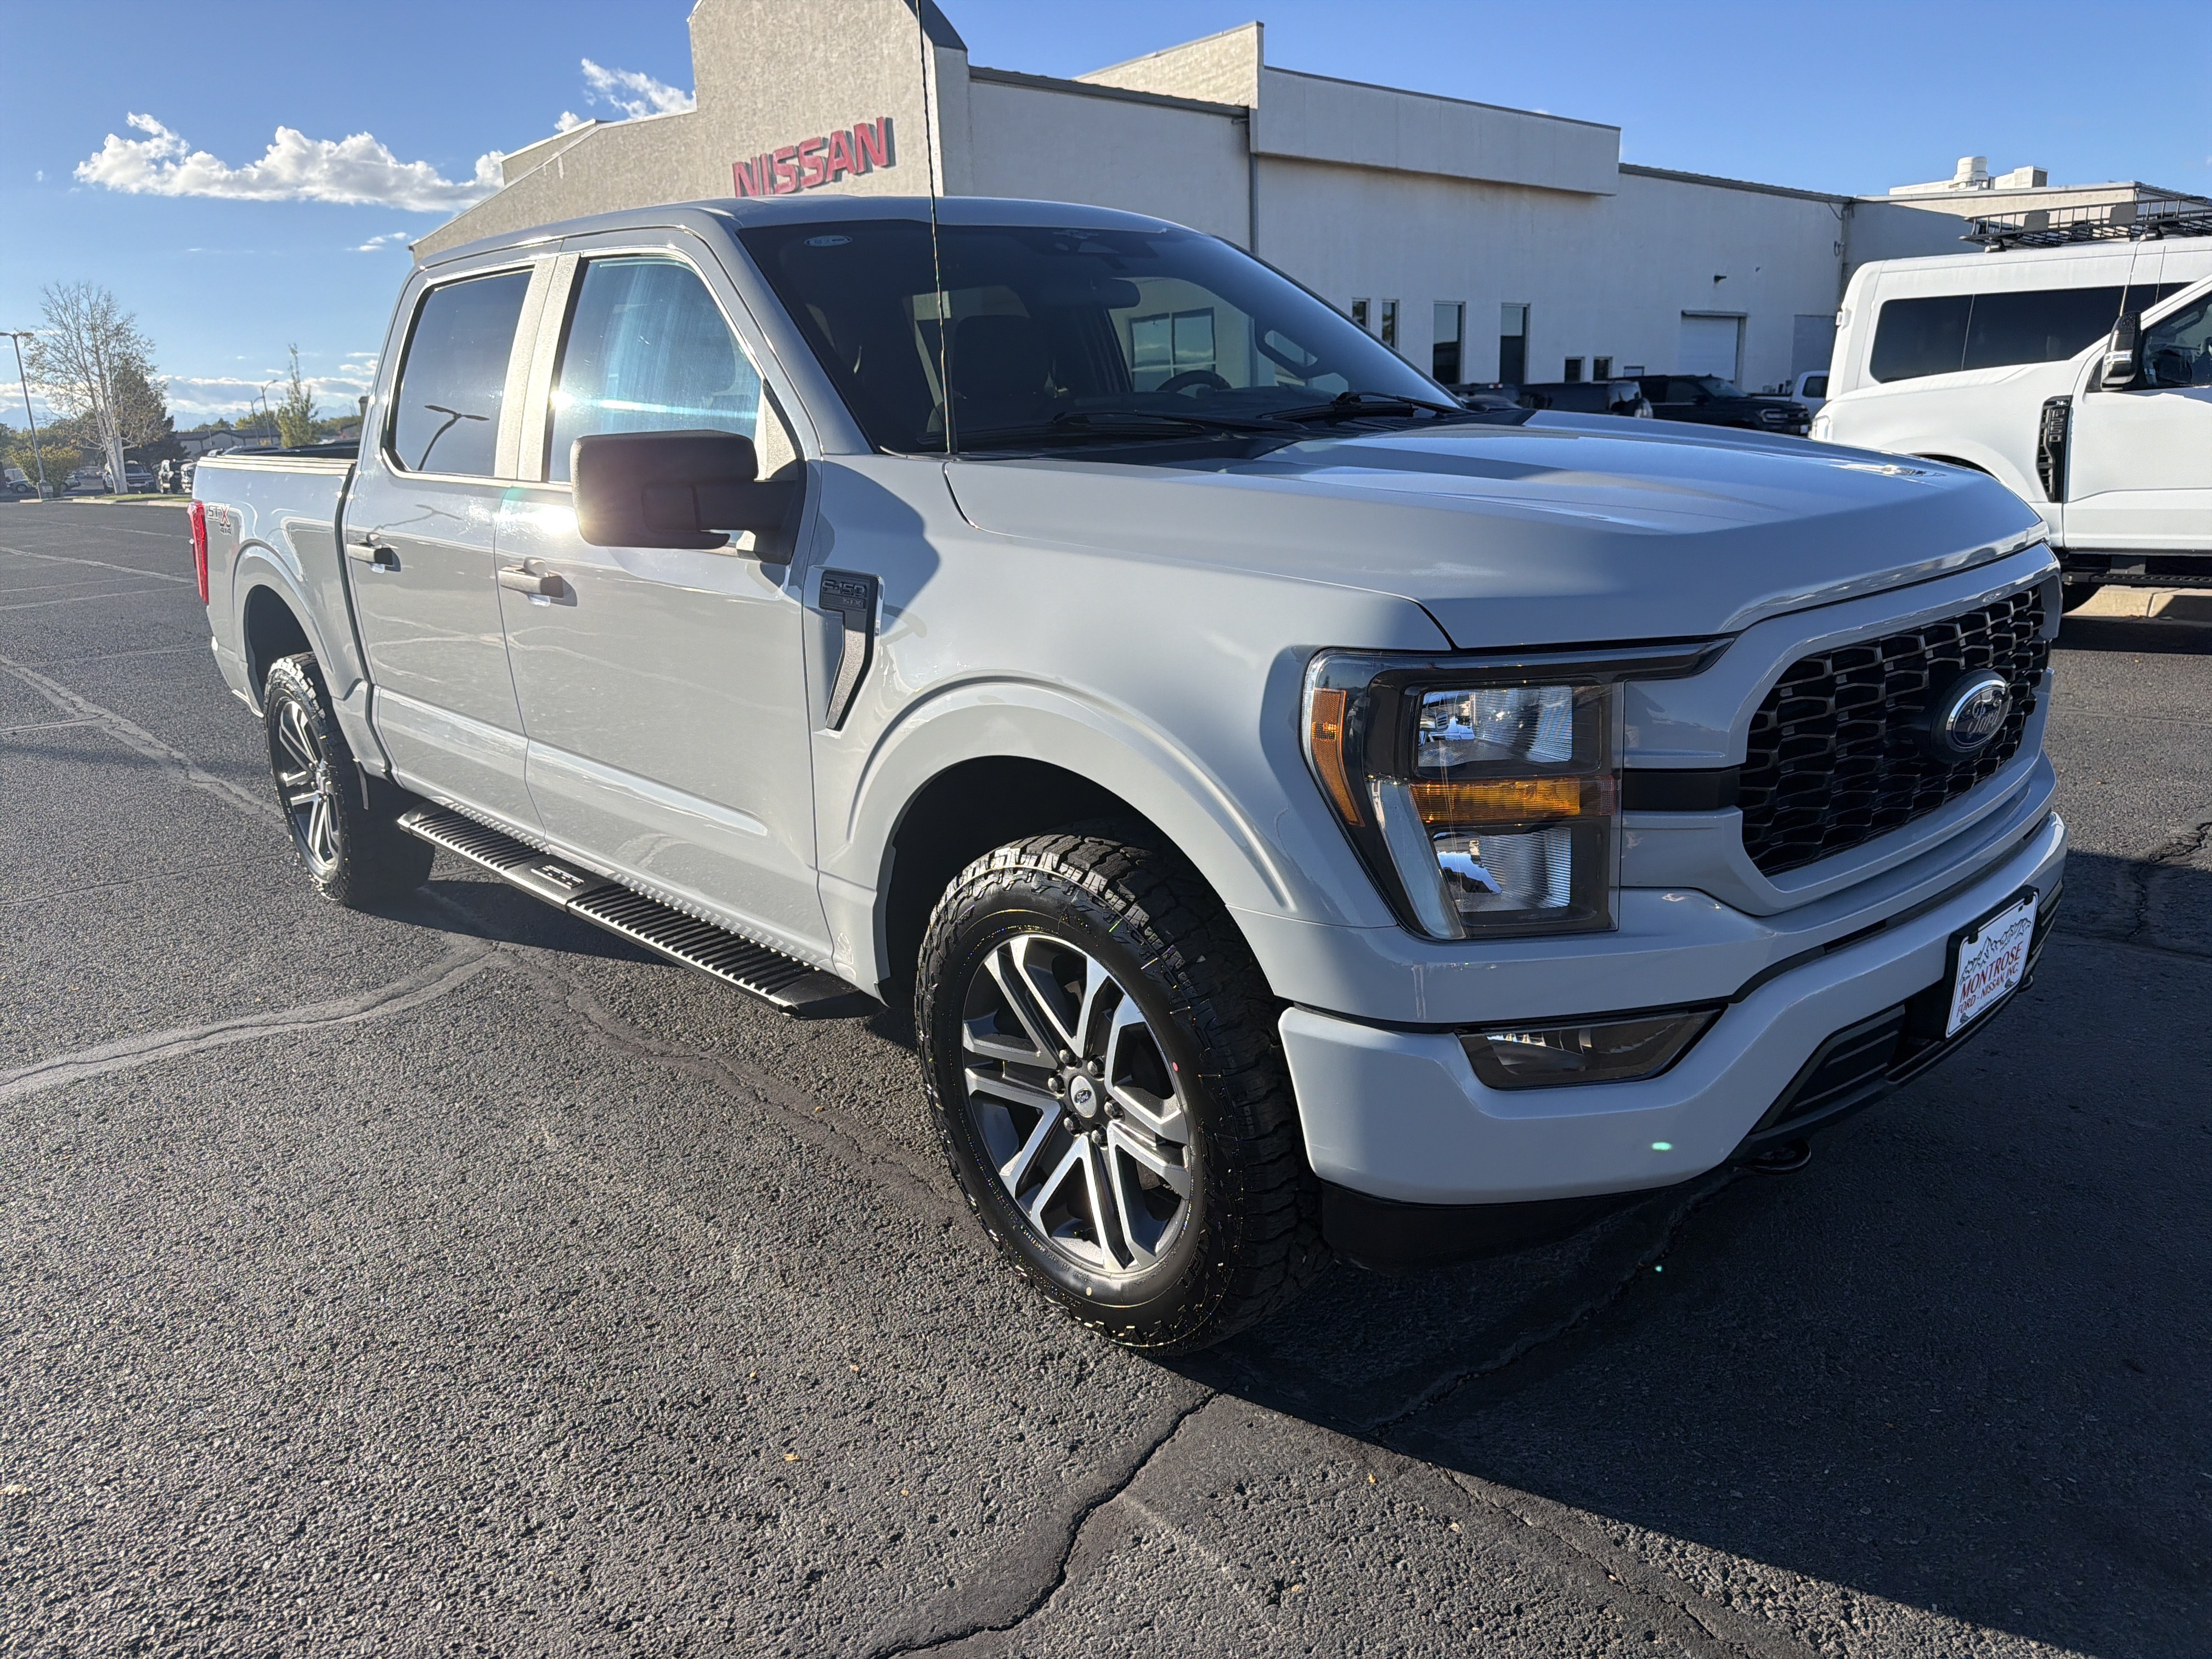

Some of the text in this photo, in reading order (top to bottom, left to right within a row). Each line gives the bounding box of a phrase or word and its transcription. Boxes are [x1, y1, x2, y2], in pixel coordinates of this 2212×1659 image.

[732, 116, 893, 198] NISSAN
[208, 504, 230, 527] STX
[822, 579, 866, 598] F-150
[843, 598, 864, 607] STX
[1967, 697, 2002, 738] Ford
[1960, 941, 2023, 1003] MONTROSE
[1956, 994, 1976, 1018] FORD
